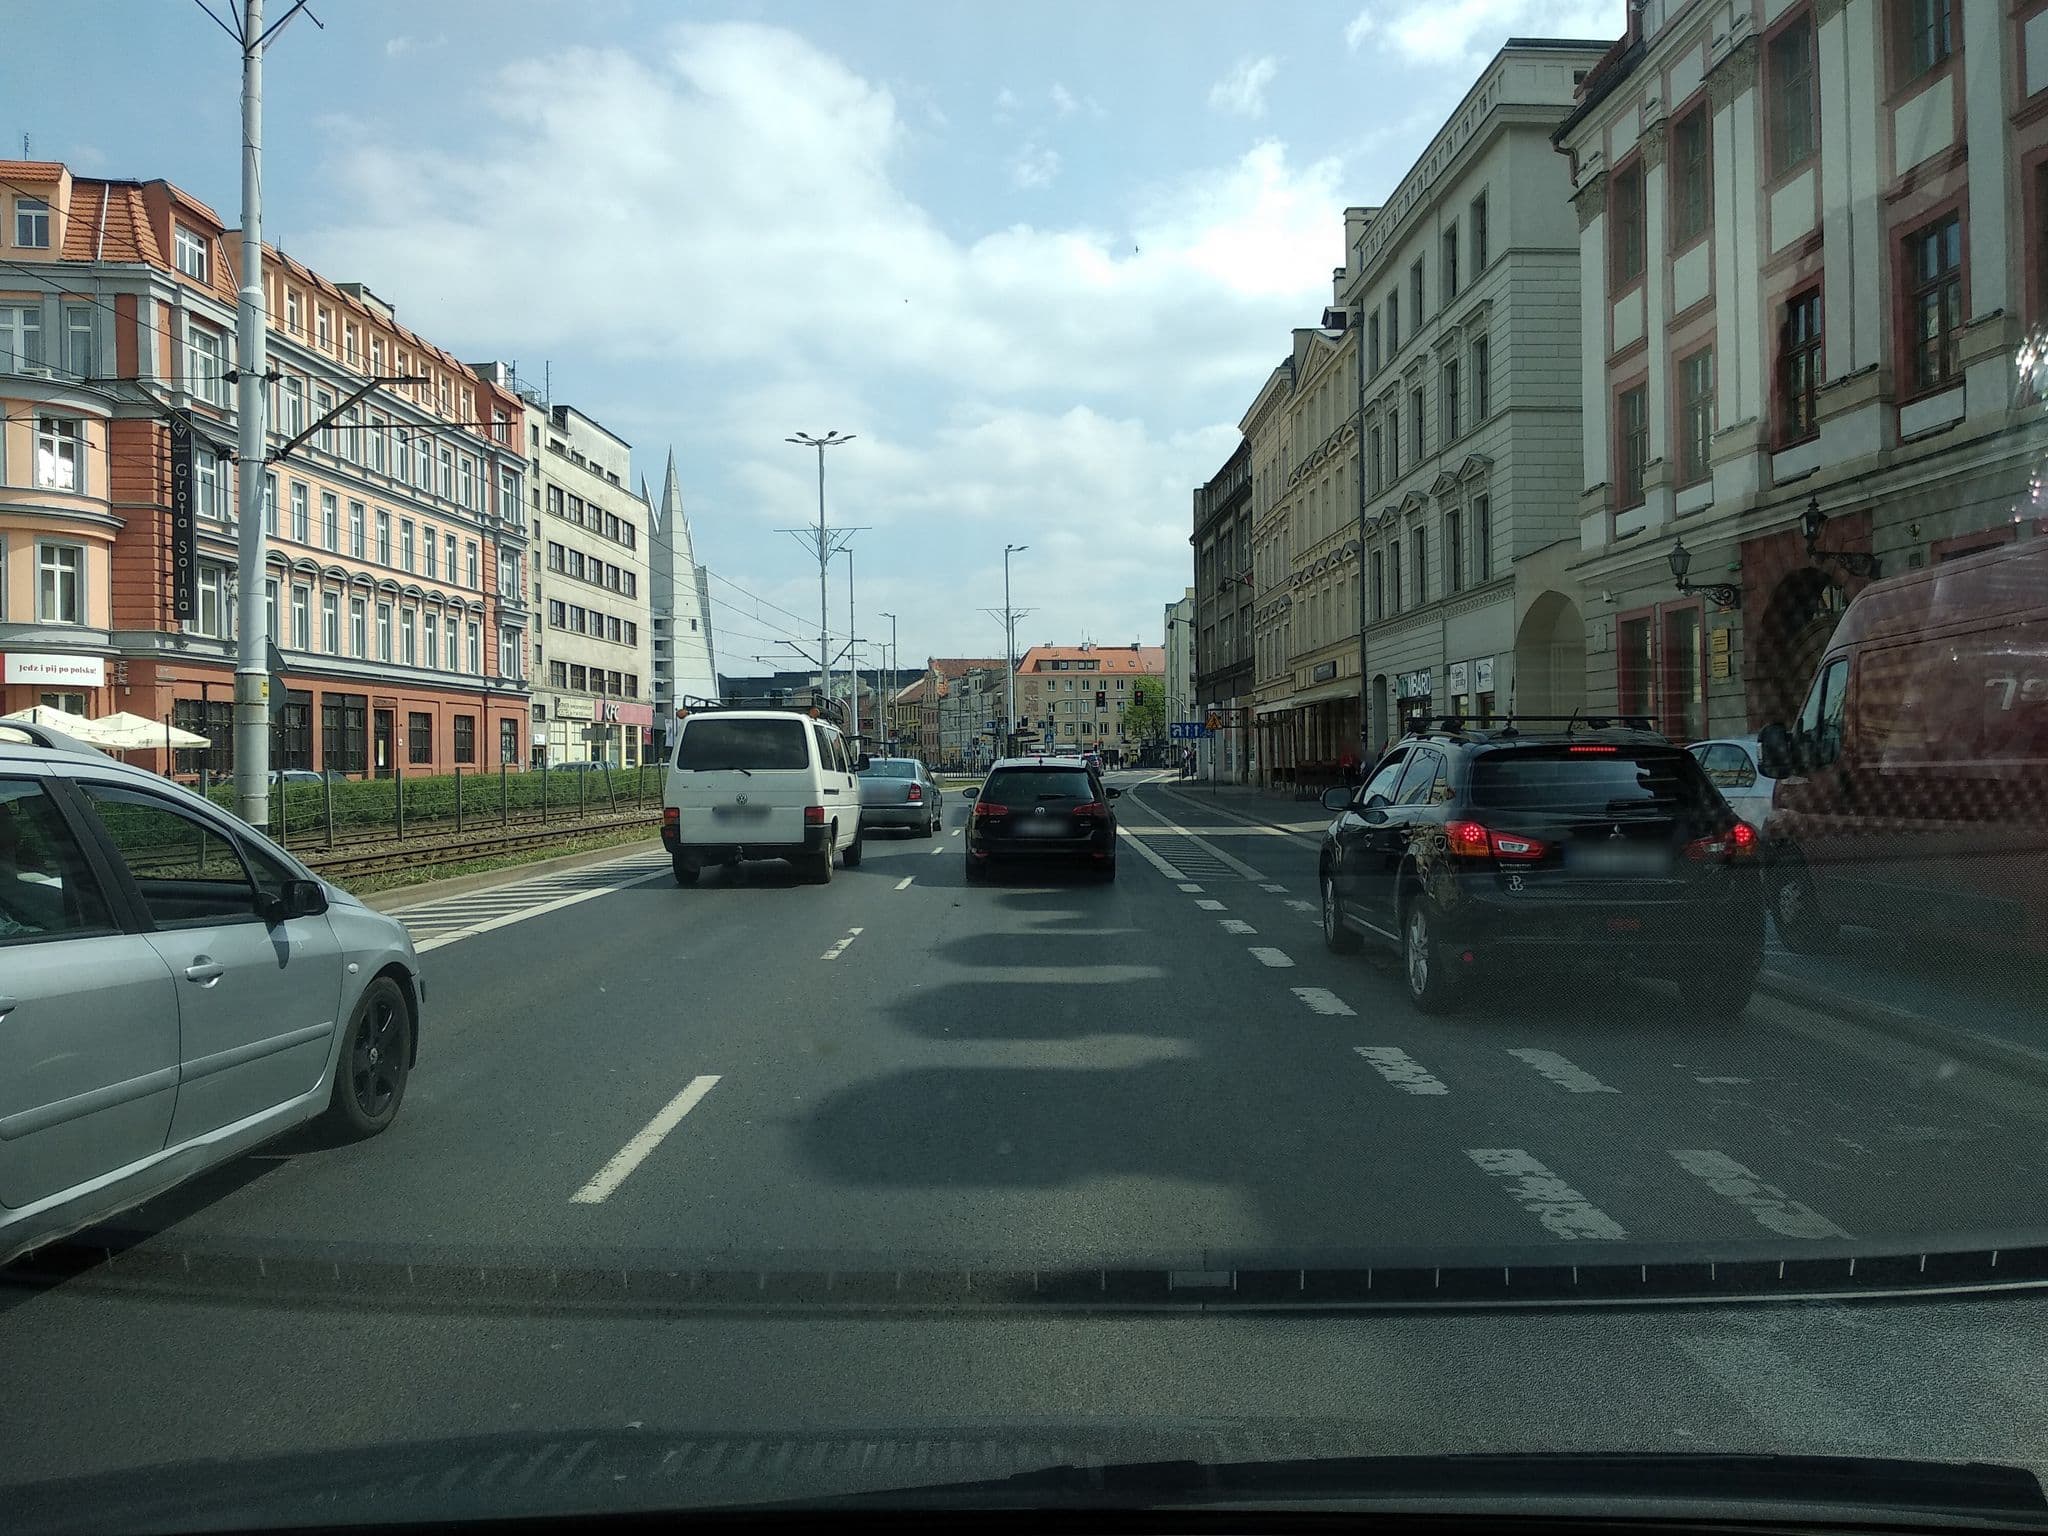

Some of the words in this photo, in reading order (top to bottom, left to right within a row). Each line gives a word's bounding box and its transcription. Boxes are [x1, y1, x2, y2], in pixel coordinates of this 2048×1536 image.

[175, 463, 188, 528] Grota
[178, 540, 189, 611] Solna
[45, 664, 57, 674] pij
[59, 666, 69, 674] po
[70, 666, 97, 674] polsku!
[1396, 669, 1432, 699] MBARD
[605, 703, 620, 720] KFC
